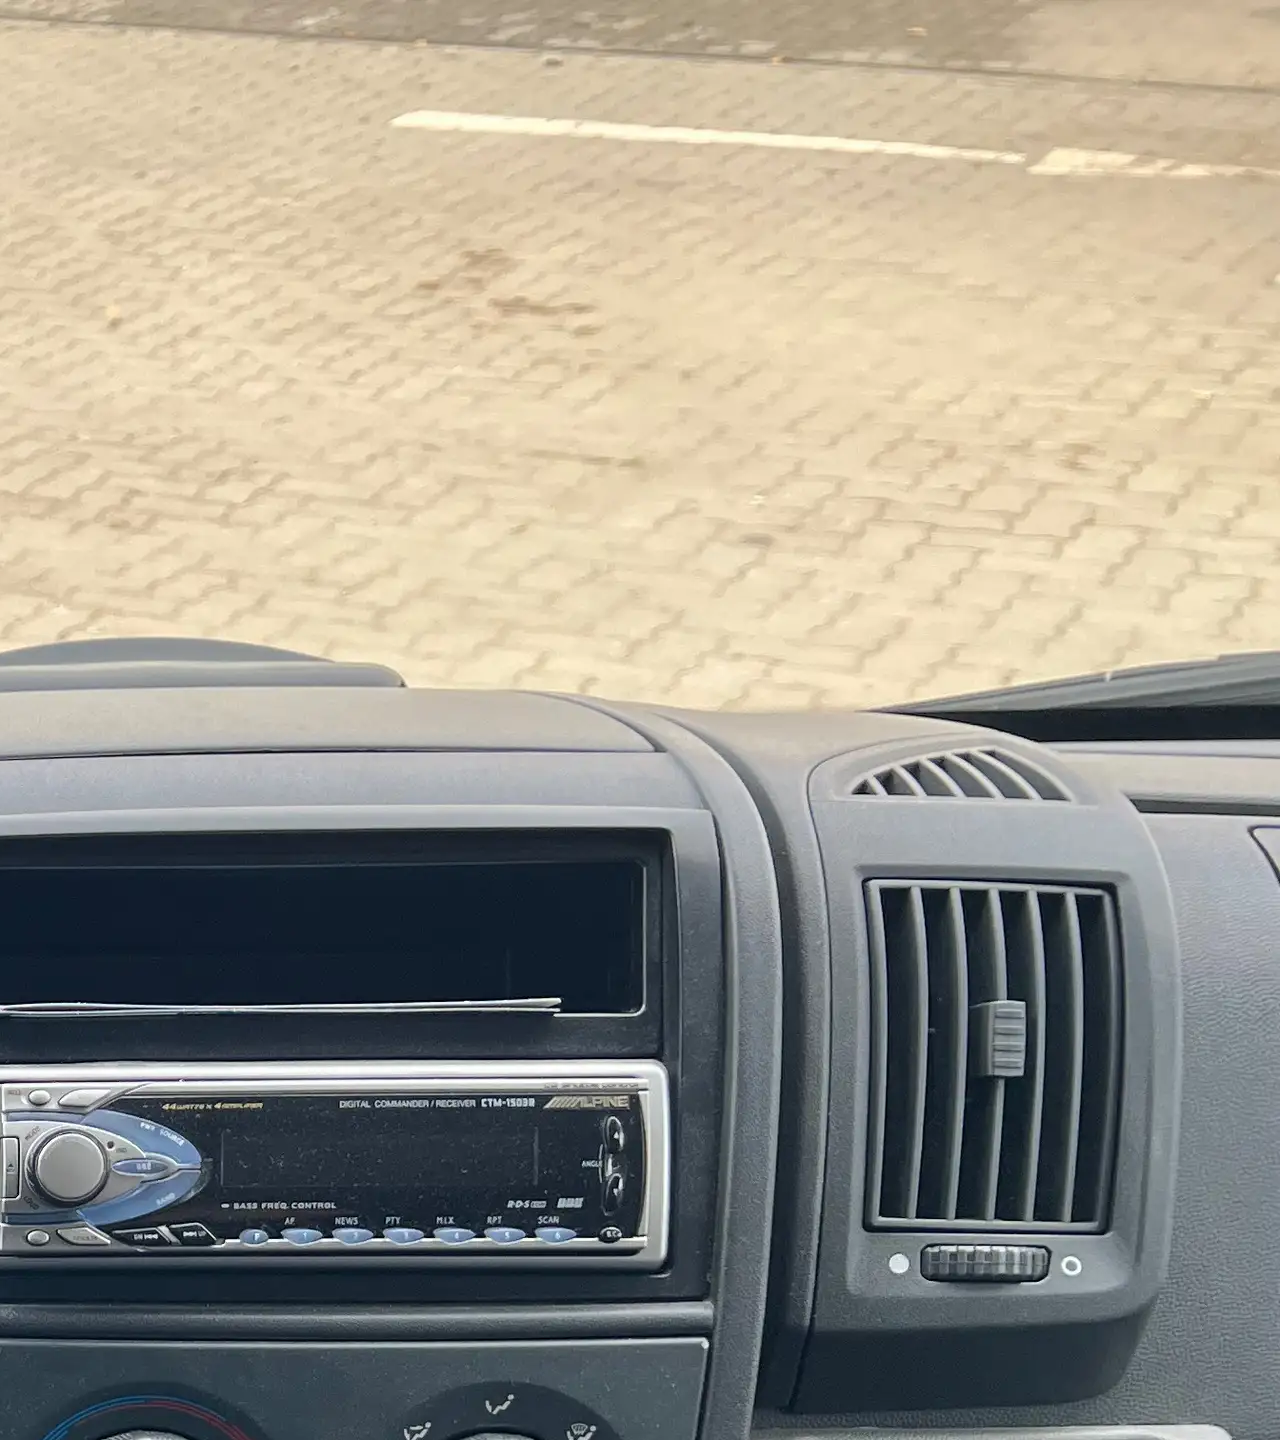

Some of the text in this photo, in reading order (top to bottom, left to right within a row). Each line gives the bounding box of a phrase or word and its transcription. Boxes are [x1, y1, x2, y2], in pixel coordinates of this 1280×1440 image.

[339, 1099, 370, 1109] DIGITAL
[554, 1095, 630, 1109] ALPINE
[233, 1202, 258, 1210] BASS
[291, 1201, 337, 1210] CONTROL
[334, 1216, 359, 1225] NEWS
[385, 1216, 401, 1225] PTY
[486, 1216, 503, 1225] RPT
[537, 1216, 560, 1225] SCAN
